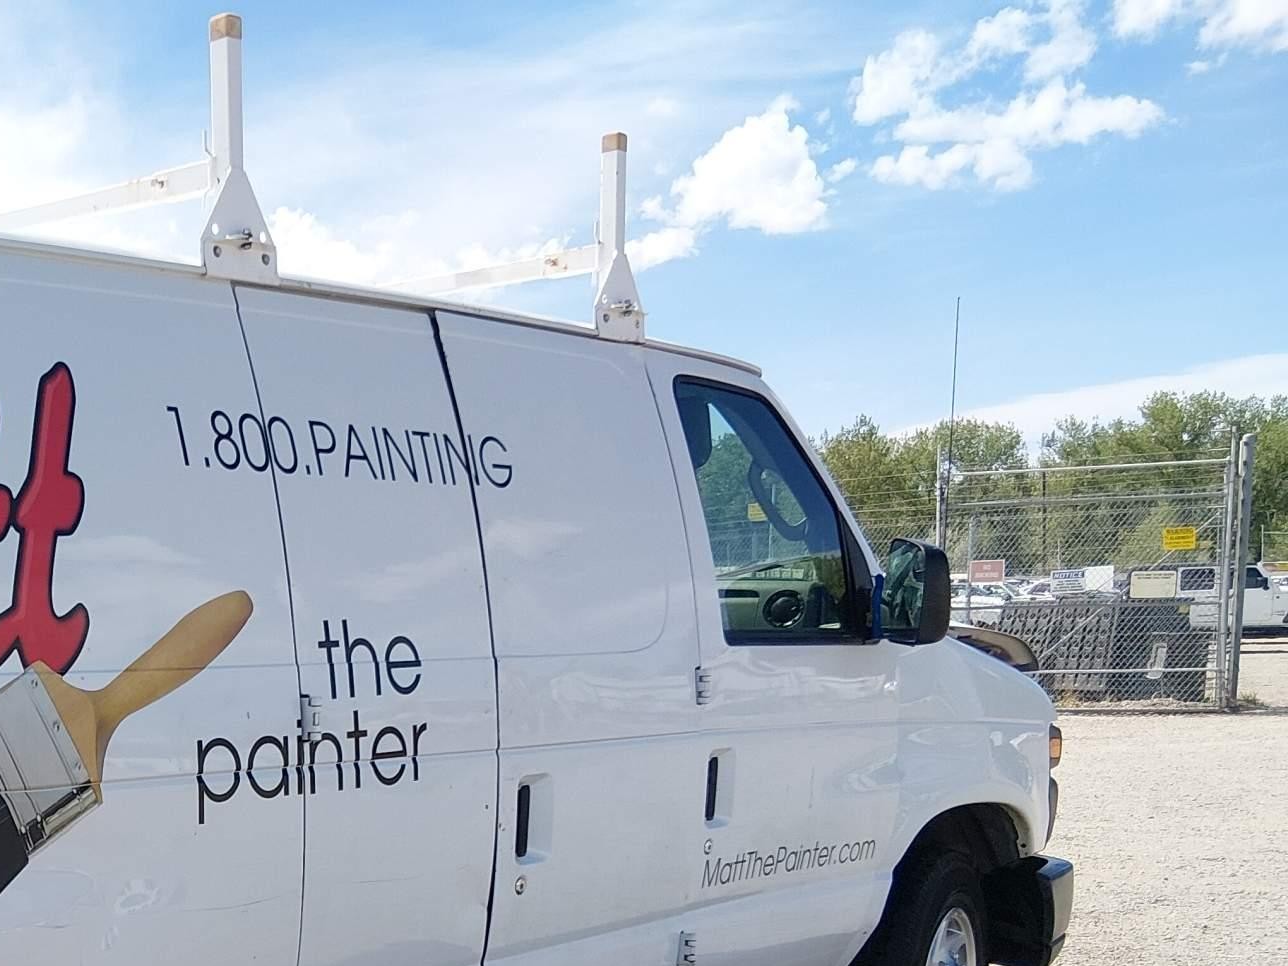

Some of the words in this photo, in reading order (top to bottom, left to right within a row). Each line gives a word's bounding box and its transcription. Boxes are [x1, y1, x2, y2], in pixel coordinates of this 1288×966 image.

[166, 406, 513, 488] 1.800.PAINTING
[1053, 571, 1083, 579] NOTICE
[318, 619, 422, 699] the
[196, 710, 428, 825] painter
[701, 839, 876, 889] MattThePainter.com
